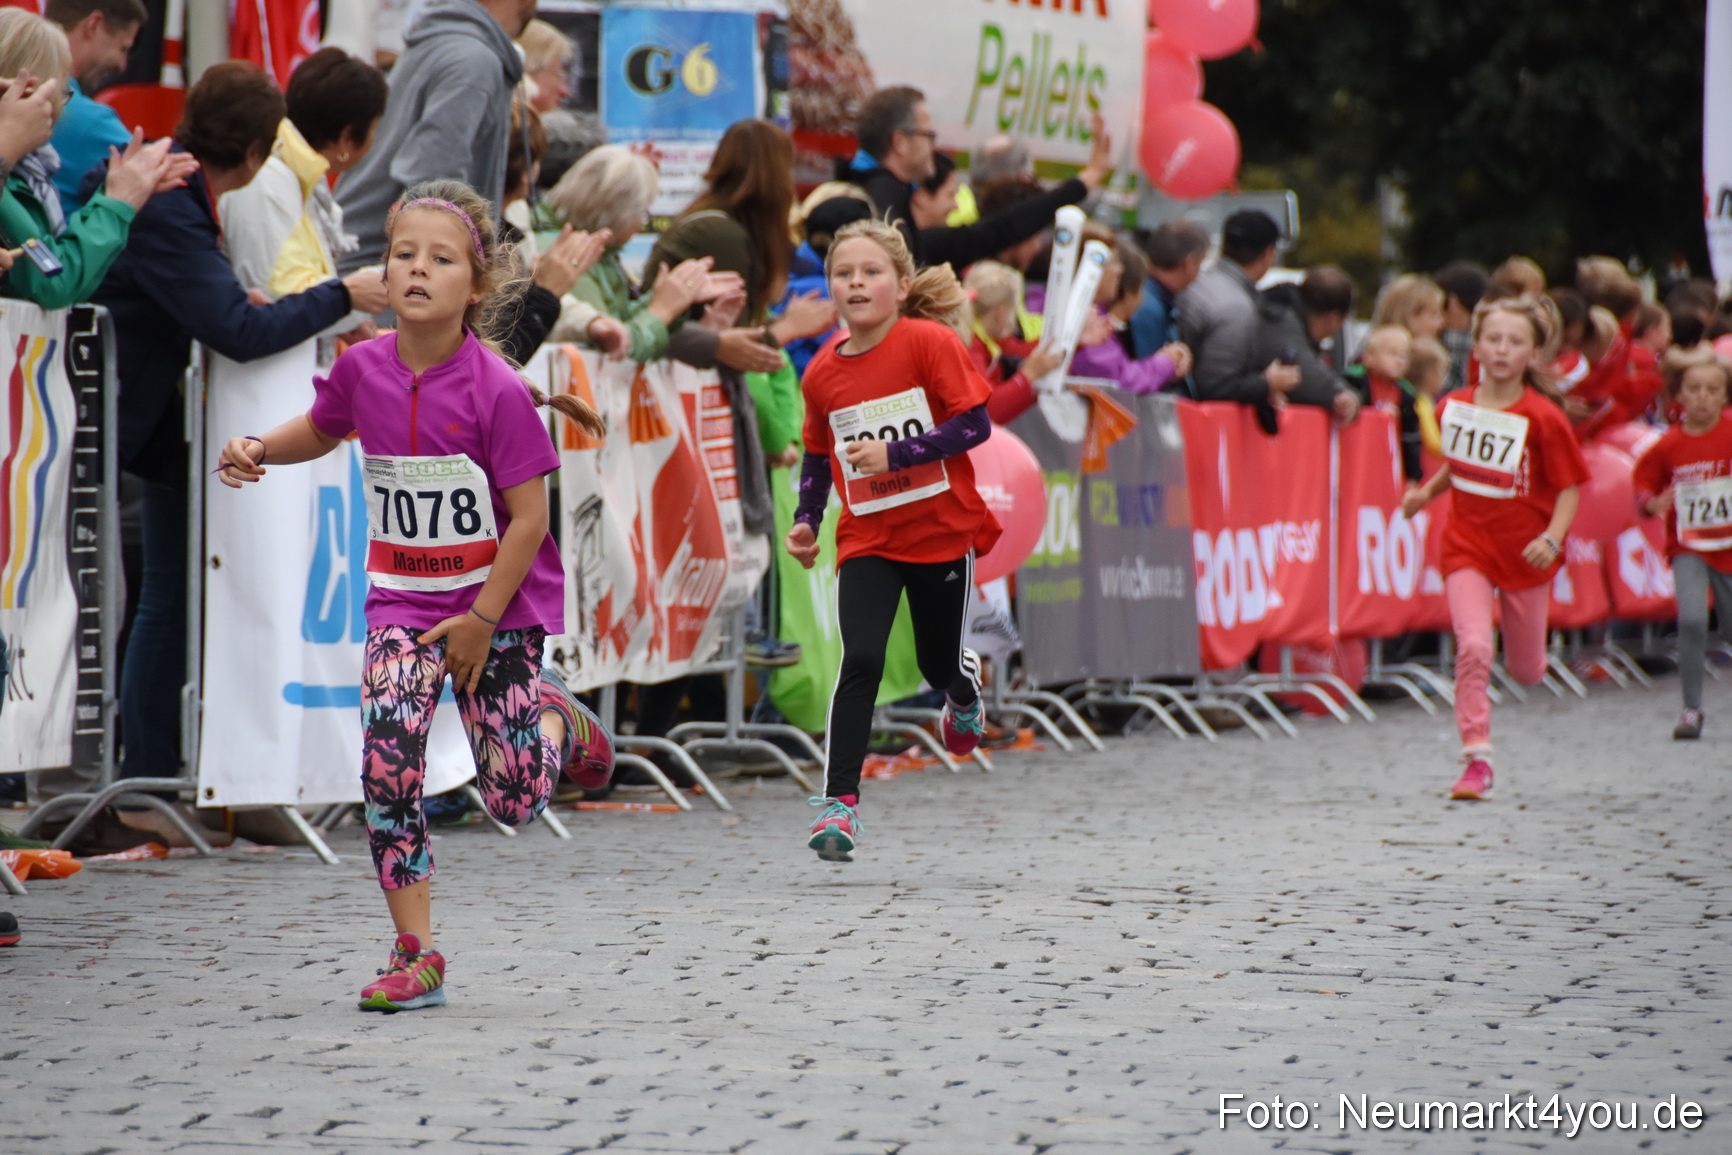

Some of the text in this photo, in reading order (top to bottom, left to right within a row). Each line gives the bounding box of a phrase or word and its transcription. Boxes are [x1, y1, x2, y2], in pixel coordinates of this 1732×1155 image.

[625, 41, 718, 97] G6
[965, 22, 1107, 143] Pellets
[863, 394, 917, 420] BOCK
[1449, 423, 1516, 465] 7167
[402, 459, 473, 477] BOCK
[869, 475, 911, 497] Ronja
[374, 485, 482, 539] 7078
[1682, 495, 1732, 524] 724
[485, 528, 493, 538] K
[393, 551, 465, 573] Marlene
